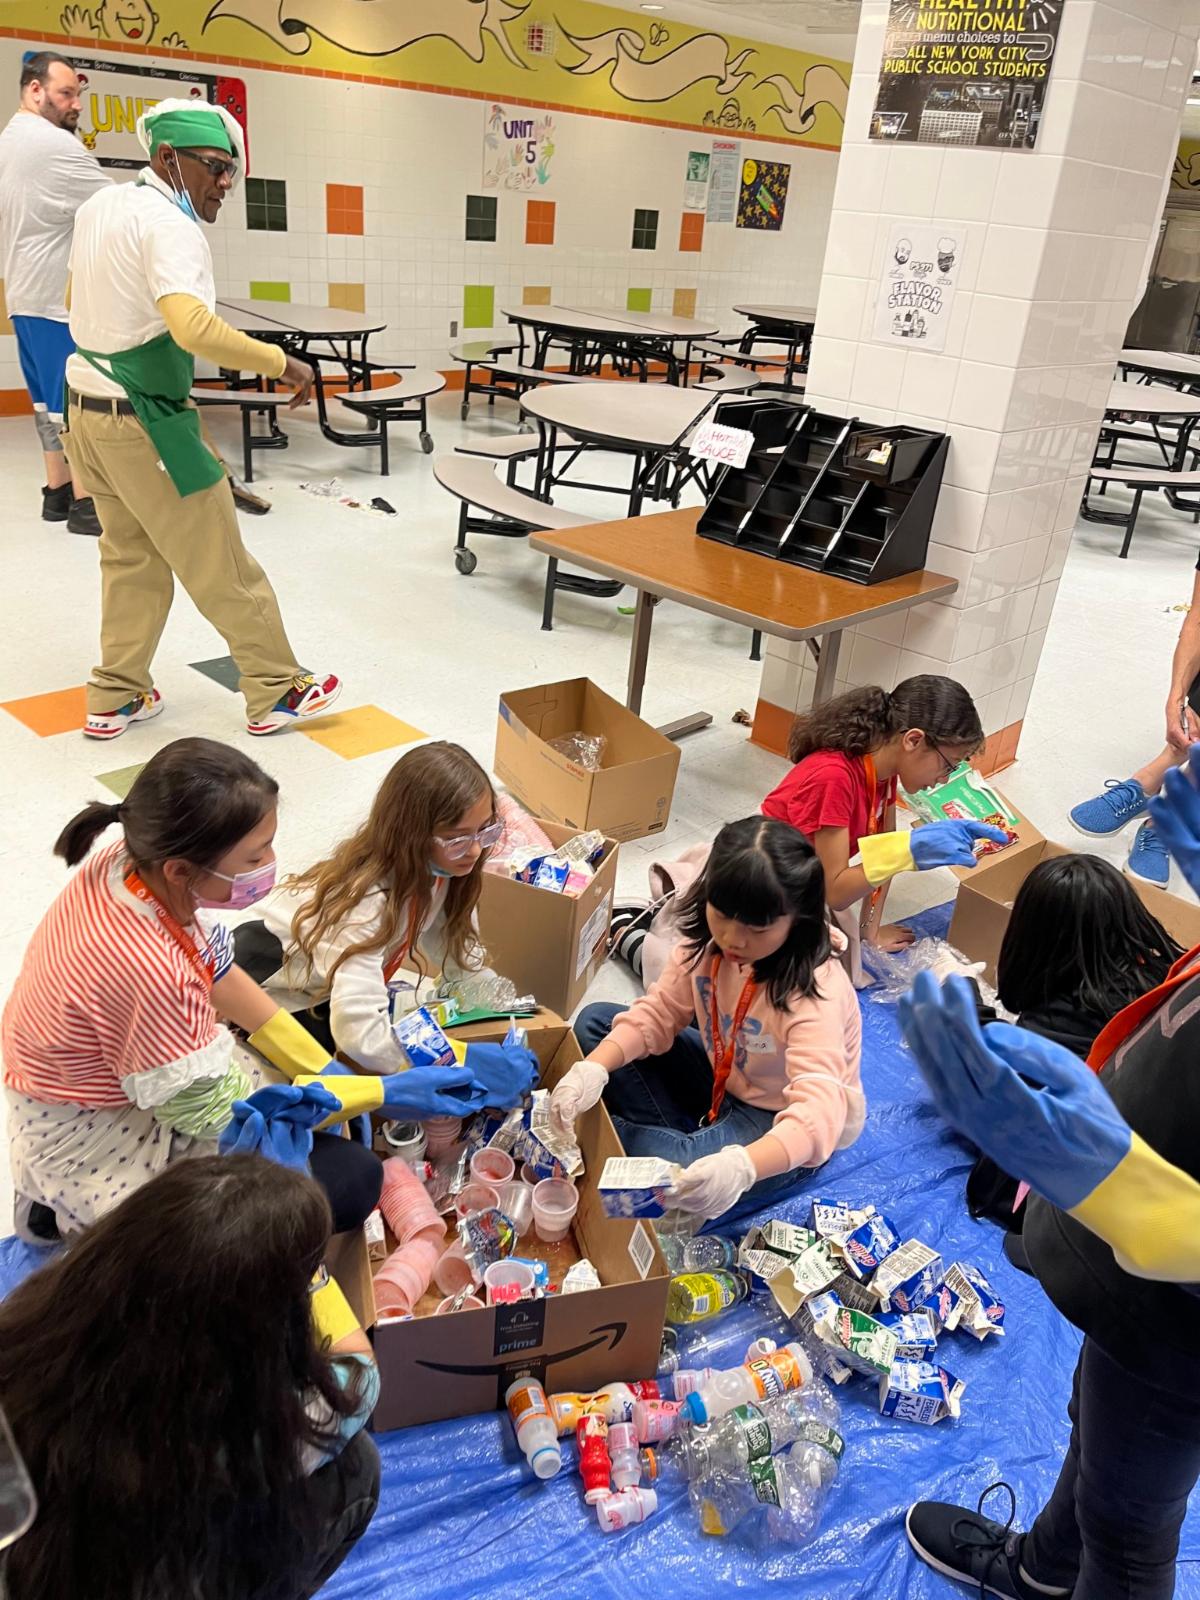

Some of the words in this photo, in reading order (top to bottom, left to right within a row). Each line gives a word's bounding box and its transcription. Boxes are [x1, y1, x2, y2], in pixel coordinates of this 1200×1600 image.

[916, 12, 1026, 31] NUTRITIONAL
[923, 33, 954, 43] menu
[957, 32, 1000, 44] choices
[1002, 33, 1016, 44] to
[906, 46, 927, 59] ALL
[931, 46, 956, 59] NEW
[961, 46, 994, 60] YORK
[998, 47, 1027, 61] CITY
[884, 60, 924, 74] PUBLIC
[926, 60, 979, 75] SCHOOL
[983, 62, 1047, 77] STUDENTS
[91, 93, 163, 134] UNI
[504, 120, 534, 139] UNIT
[525, 140, 537, 164] 5
[893, 281, 943, 301] FLAVOR
[888, 294, 943, 315] STATION
[698, 440, 736, 461] SAUCE
[500, 1339, 537, 1353] prime
[920, 1399, 935, 1423] FEARLESS
